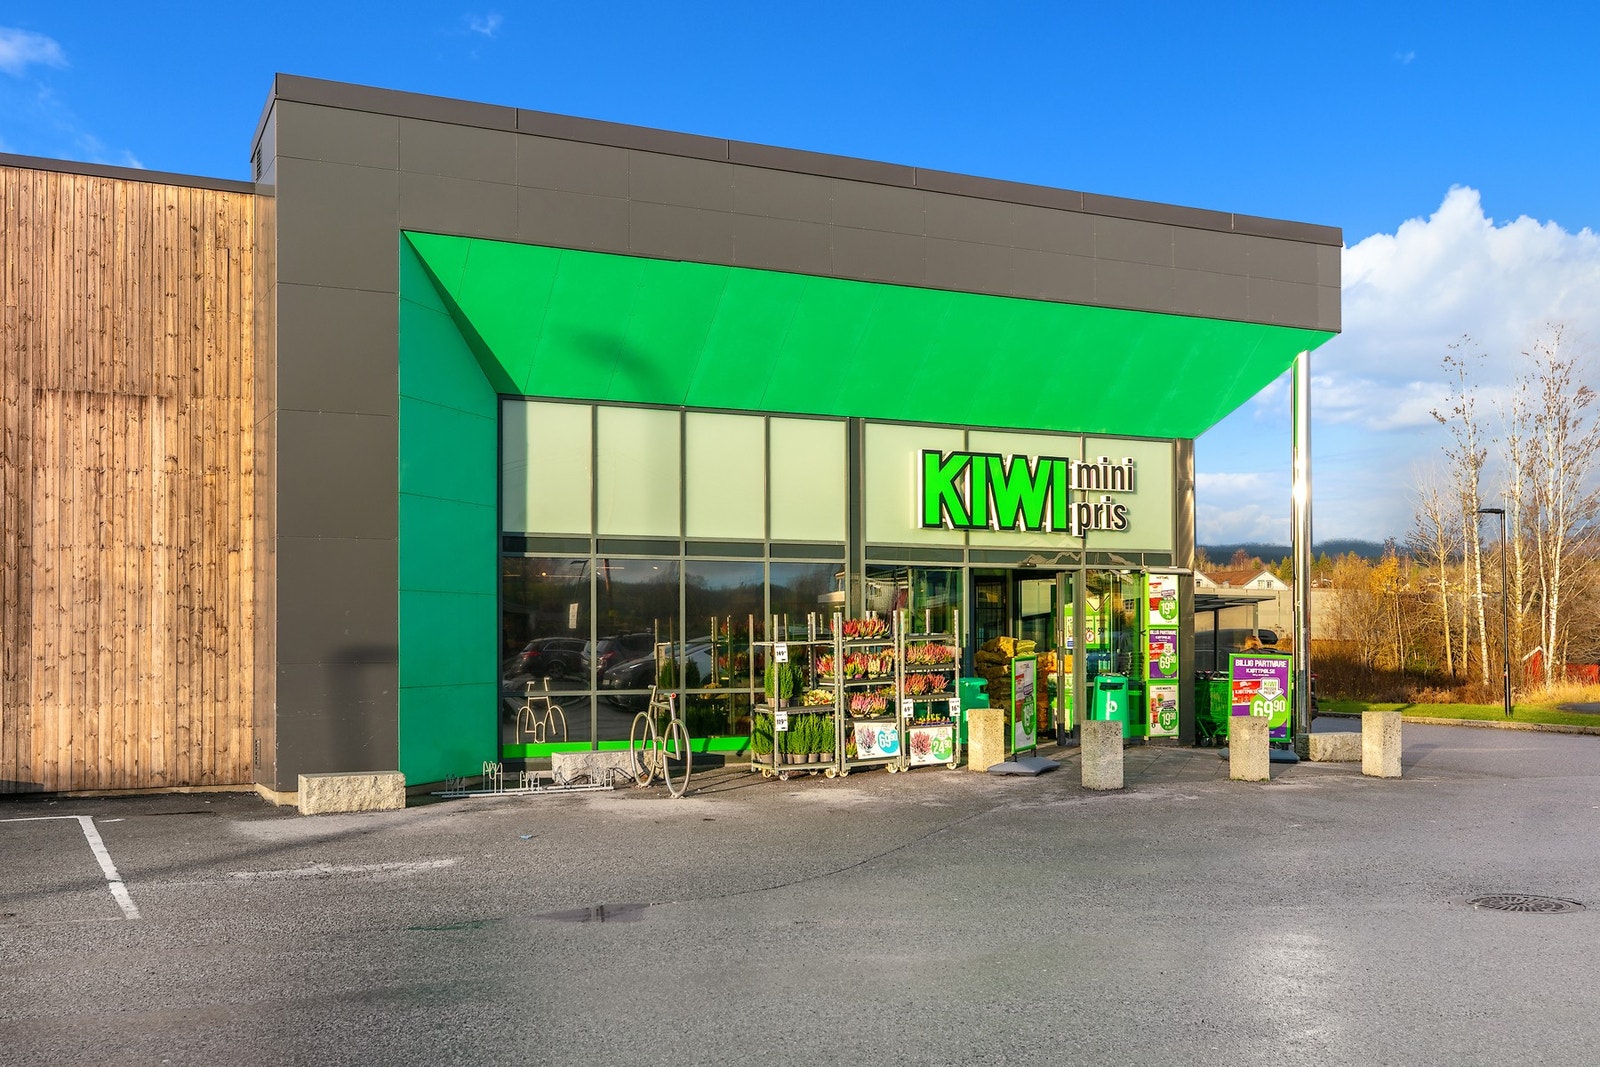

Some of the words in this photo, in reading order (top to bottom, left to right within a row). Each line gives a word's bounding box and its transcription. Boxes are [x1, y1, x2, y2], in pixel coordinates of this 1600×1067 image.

[919, 449, 1069, 532] KIWI
[1073, 456, 1134, 491] mini
[1073, 495, 1128, 537] pris
